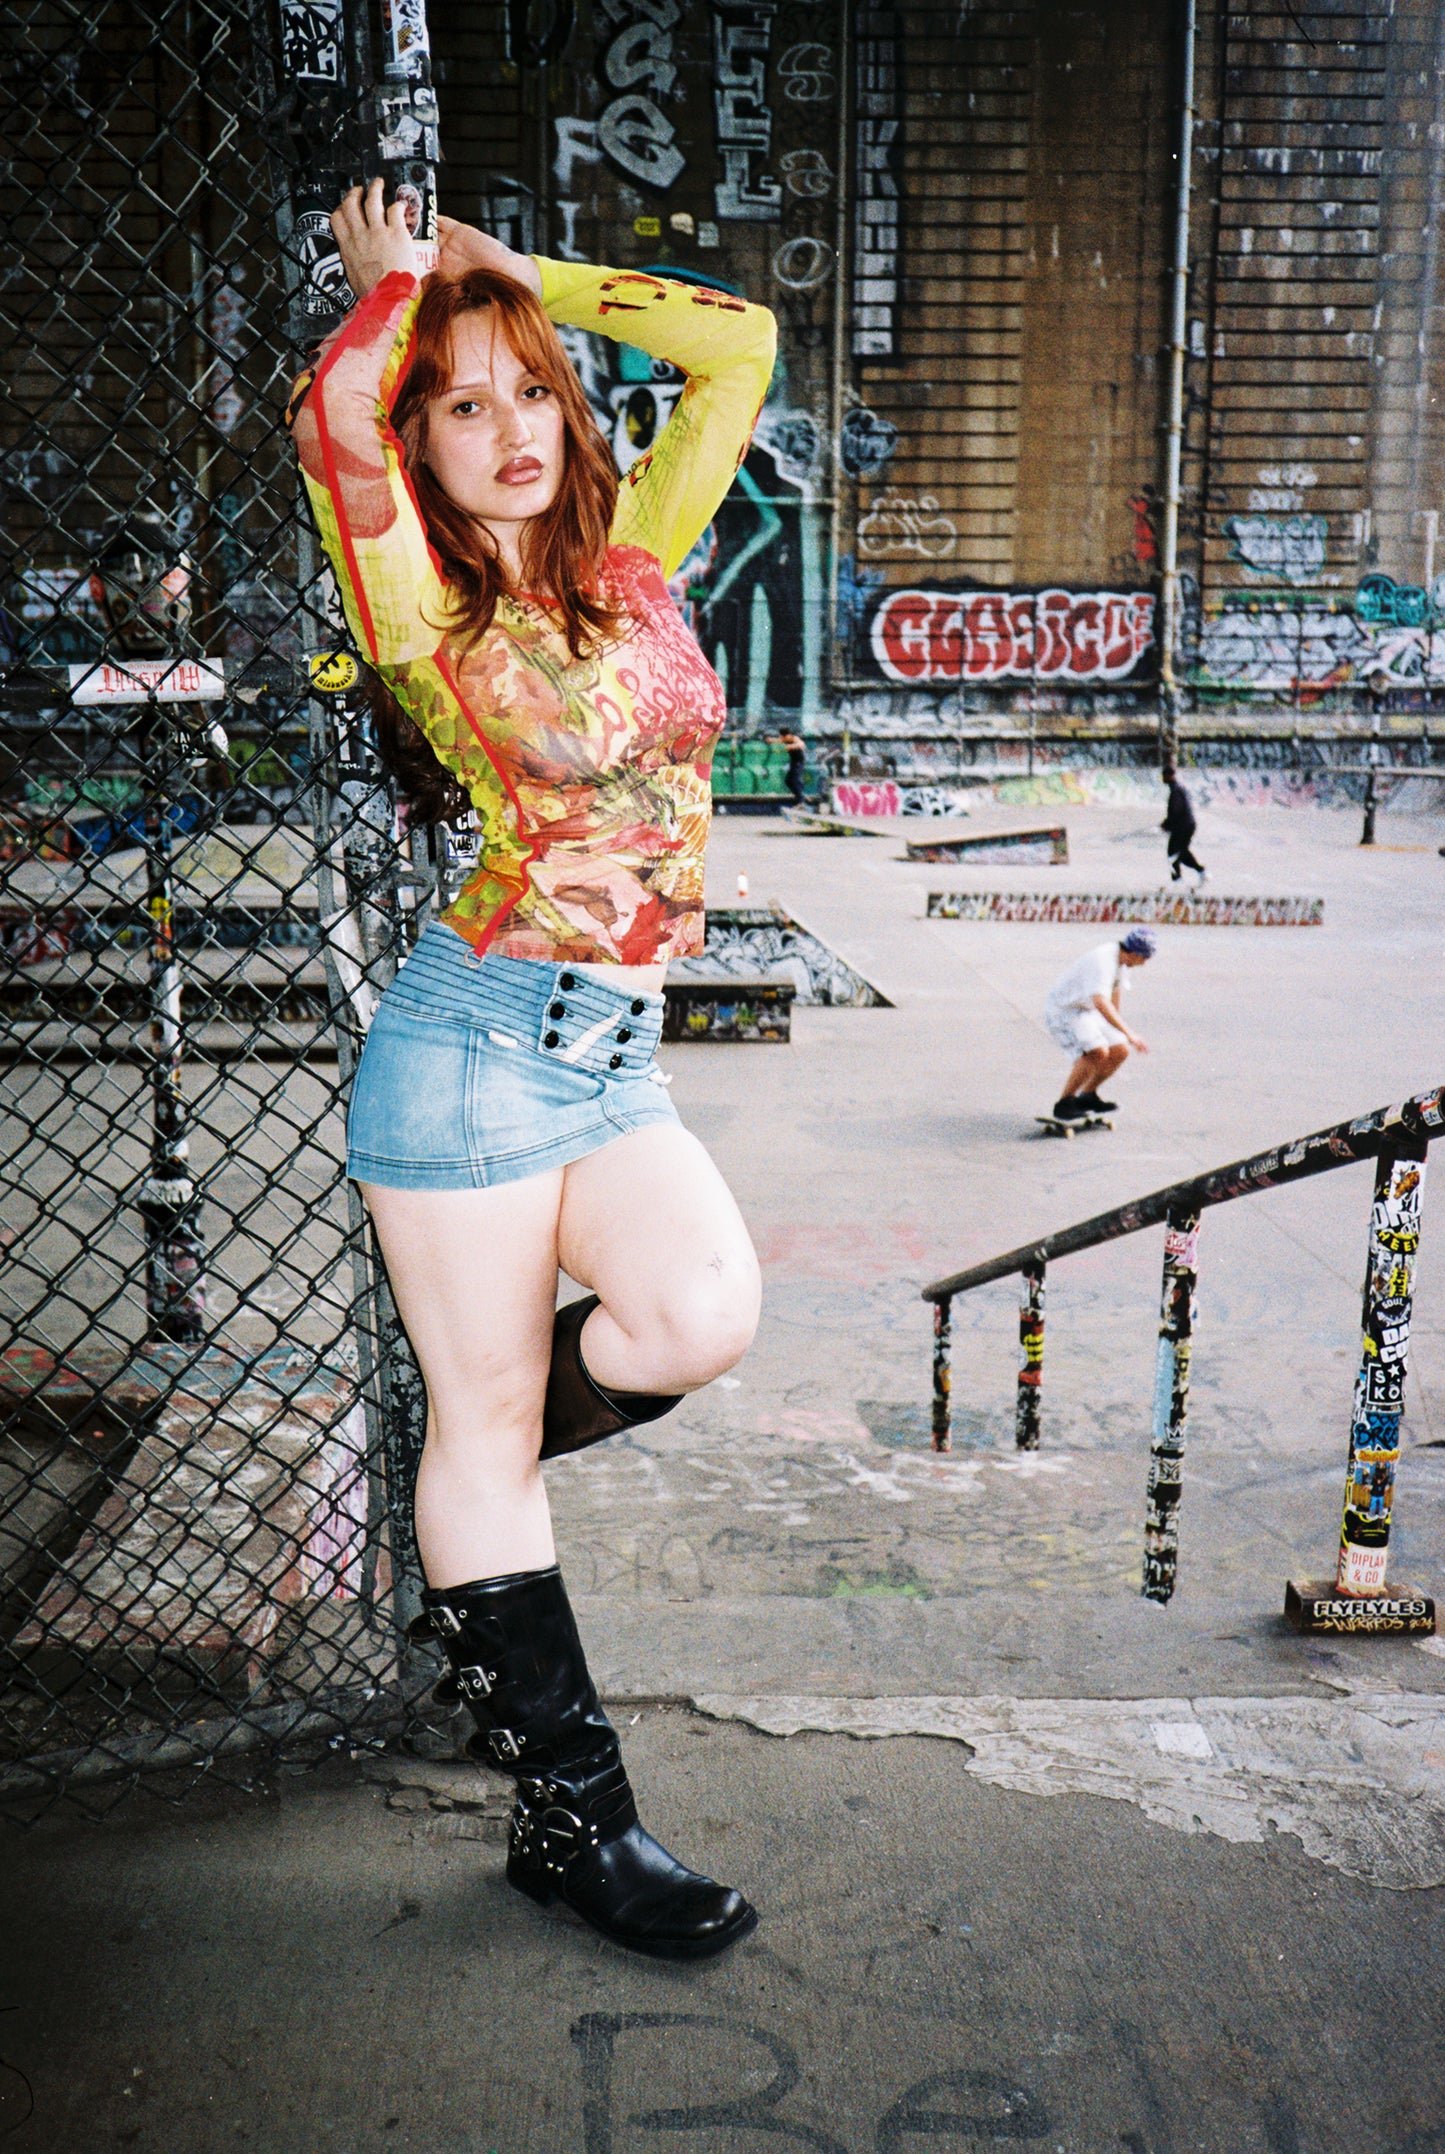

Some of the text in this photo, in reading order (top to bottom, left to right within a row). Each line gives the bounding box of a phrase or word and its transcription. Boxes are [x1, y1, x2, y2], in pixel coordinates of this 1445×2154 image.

[1353, 1569, 1379, 1584] & CO
[1314, 1601, 1427, 1618] FLYFLYLES
